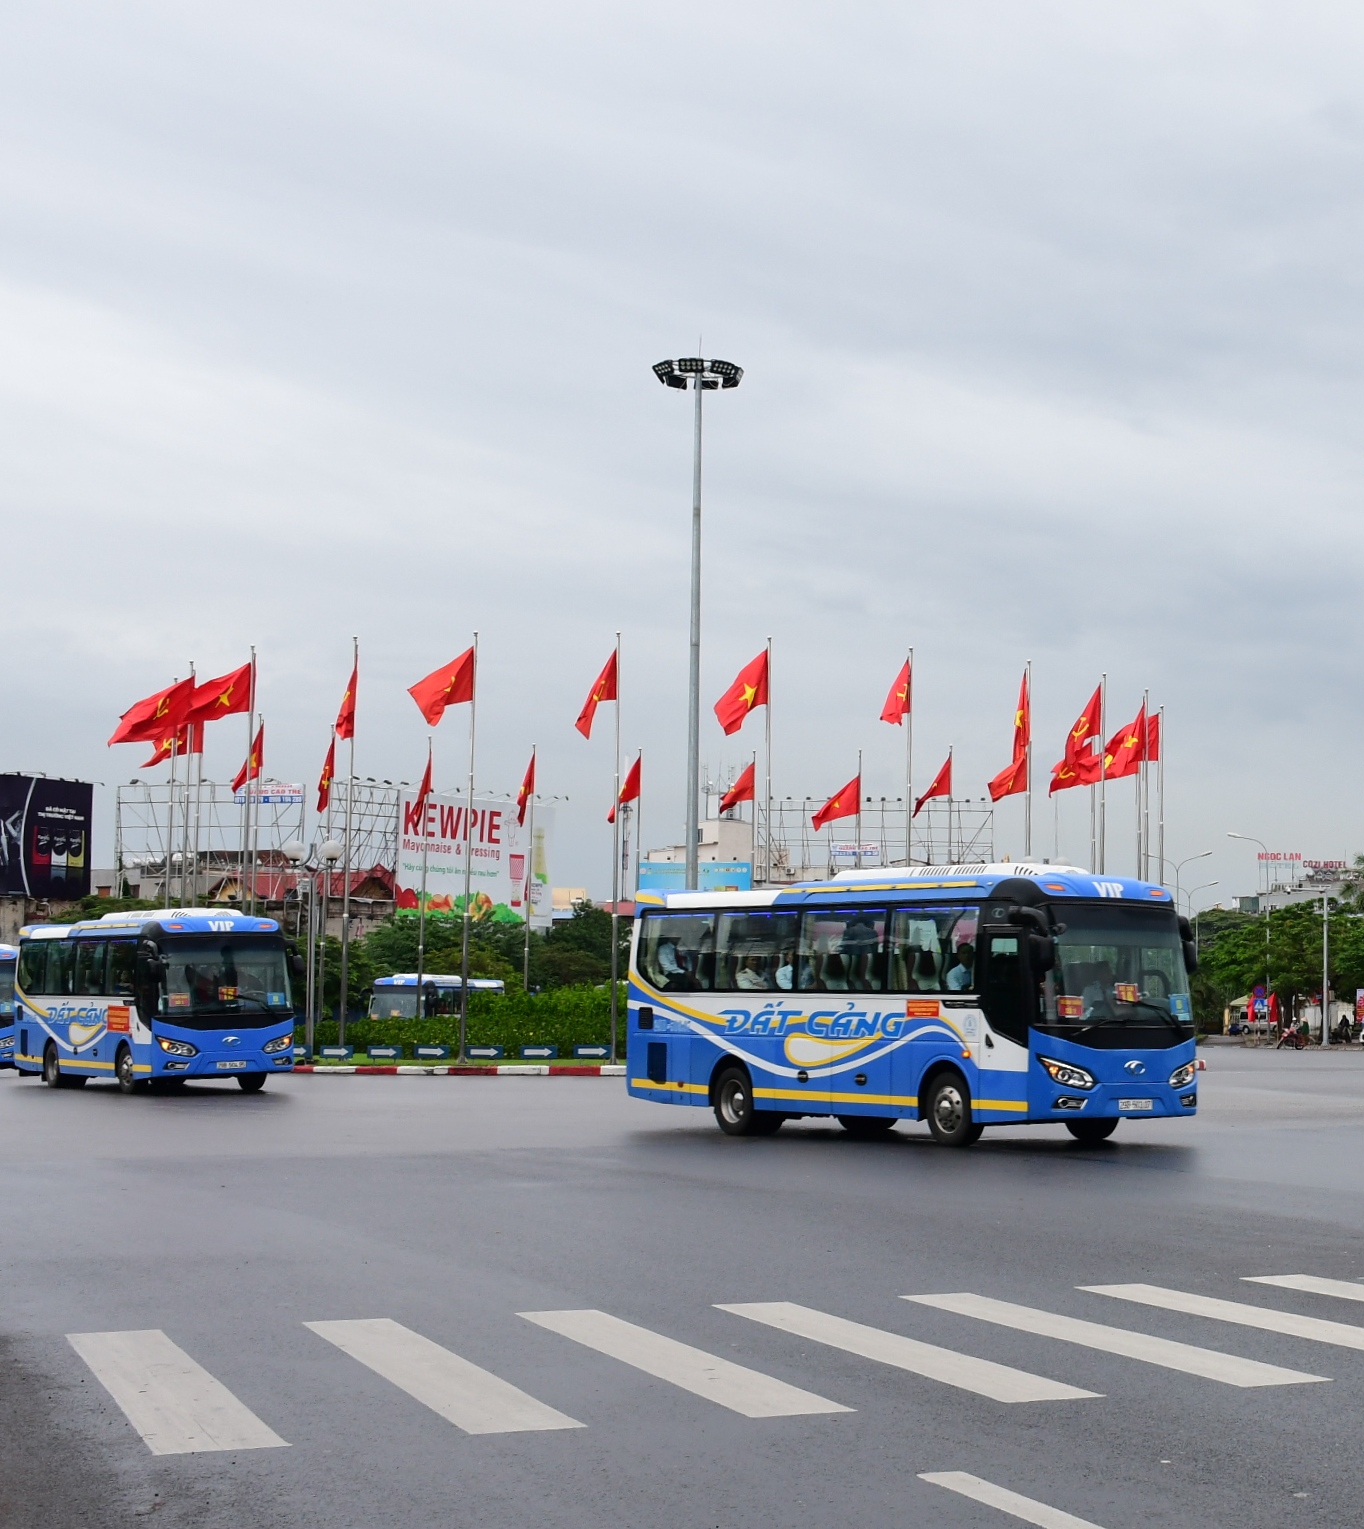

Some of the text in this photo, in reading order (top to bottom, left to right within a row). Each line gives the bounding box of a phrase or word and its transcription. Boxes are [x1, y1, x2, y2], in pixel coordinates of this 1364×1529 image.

[403, 801, 502, 844] KEWPIE
[455, 844, 461, 855] &
[465, 845, 500, 861] ressing
[1284, 852, 1301, 860] LAN
[1323, 861, 1346, 869] HOTEL
[1092, 882, 1125, 898] VIP
[208, 921, 235, 932] VIP
[45, 1001, 75, 1024] ĐẤT
[717, 1001, 803, 1035] ĐẤT
[806, 1002, 906, 1038] CẢNG
